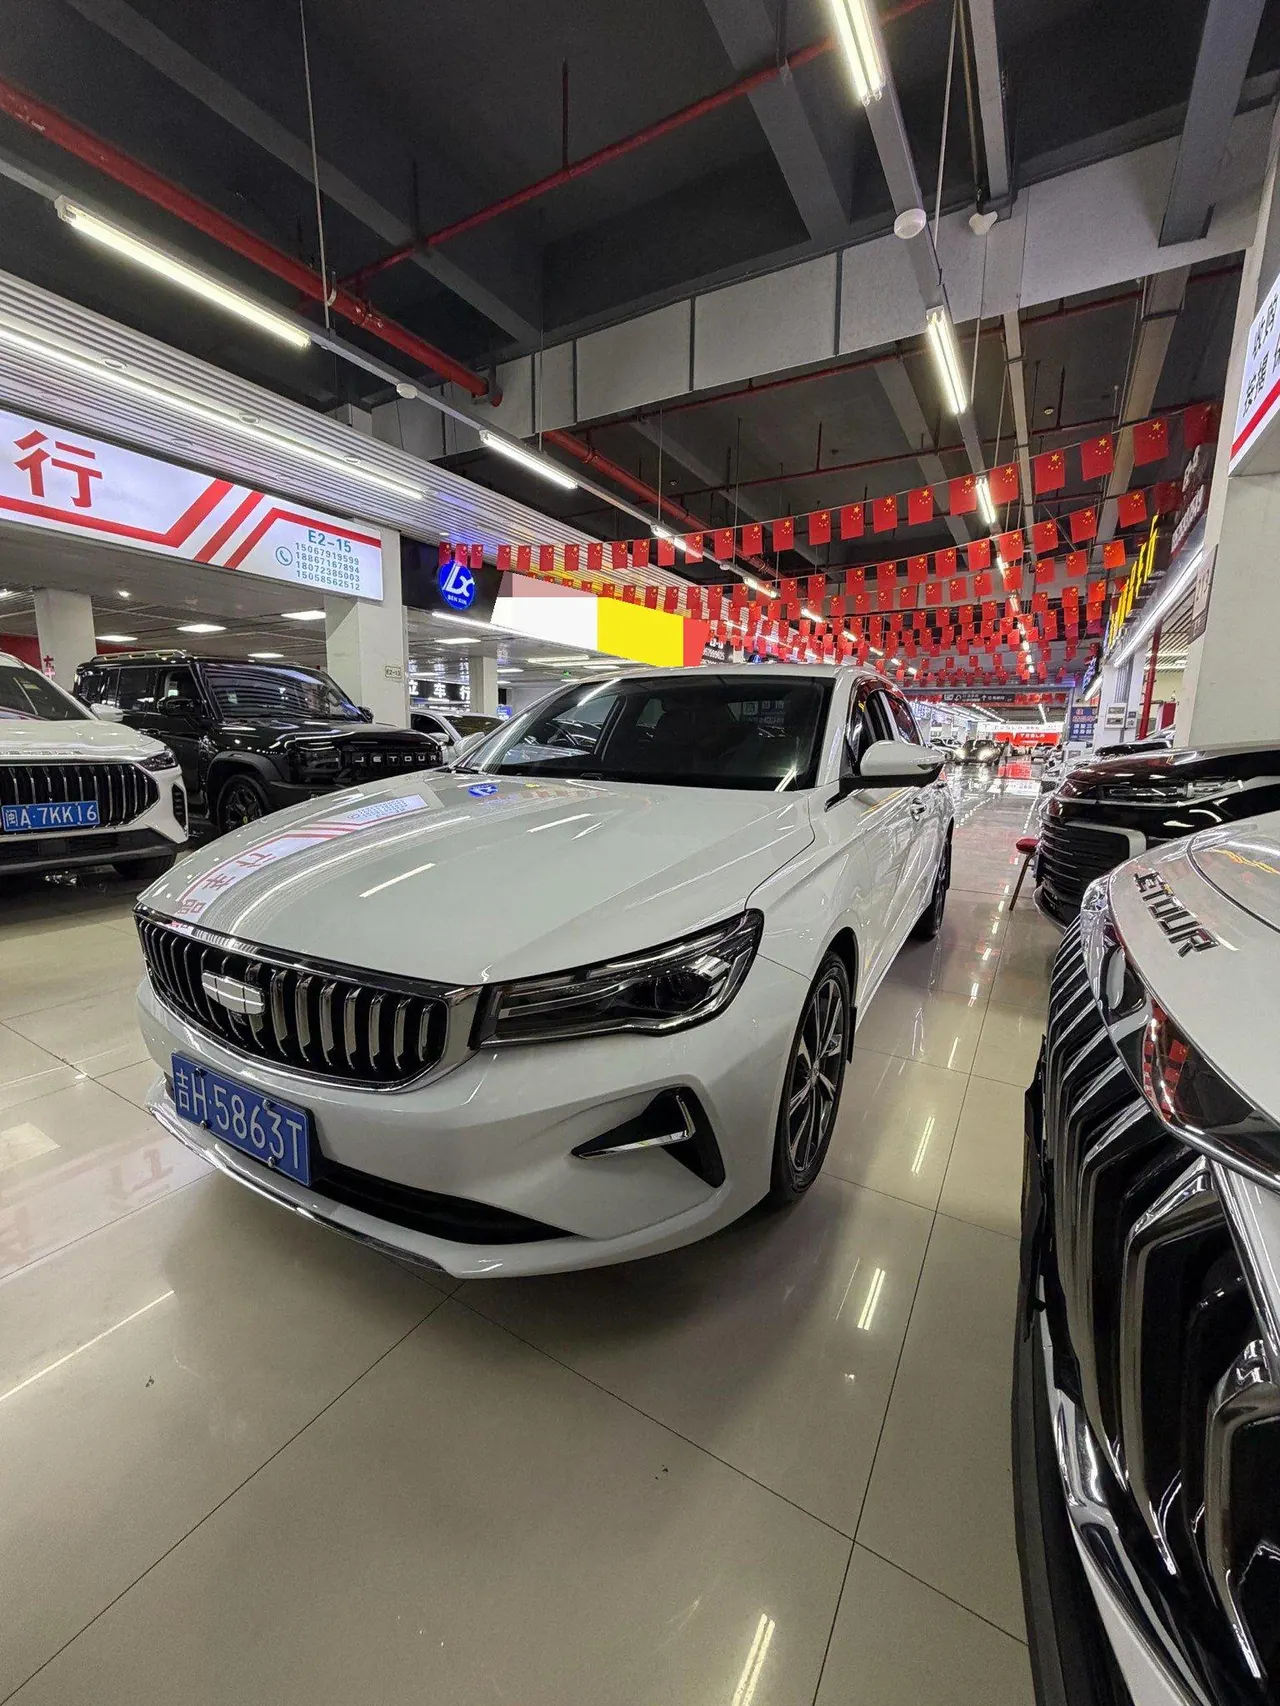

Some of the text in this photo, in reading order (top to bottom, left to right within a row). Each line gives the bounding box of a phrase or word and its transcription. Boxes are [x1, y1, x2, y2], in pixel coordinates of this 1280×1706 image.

[13, 429, 103, 508] 行
[307, 529, 352, 553] E2-15
[295, 542, 360, 566] 15067919599
[295, 551, 360, 574] 18867167894
[295, 560, 360, 583] 18072385003
[296, 570, 360, 591] 15058562512
[354, 755, 437, 763] JETOUR
